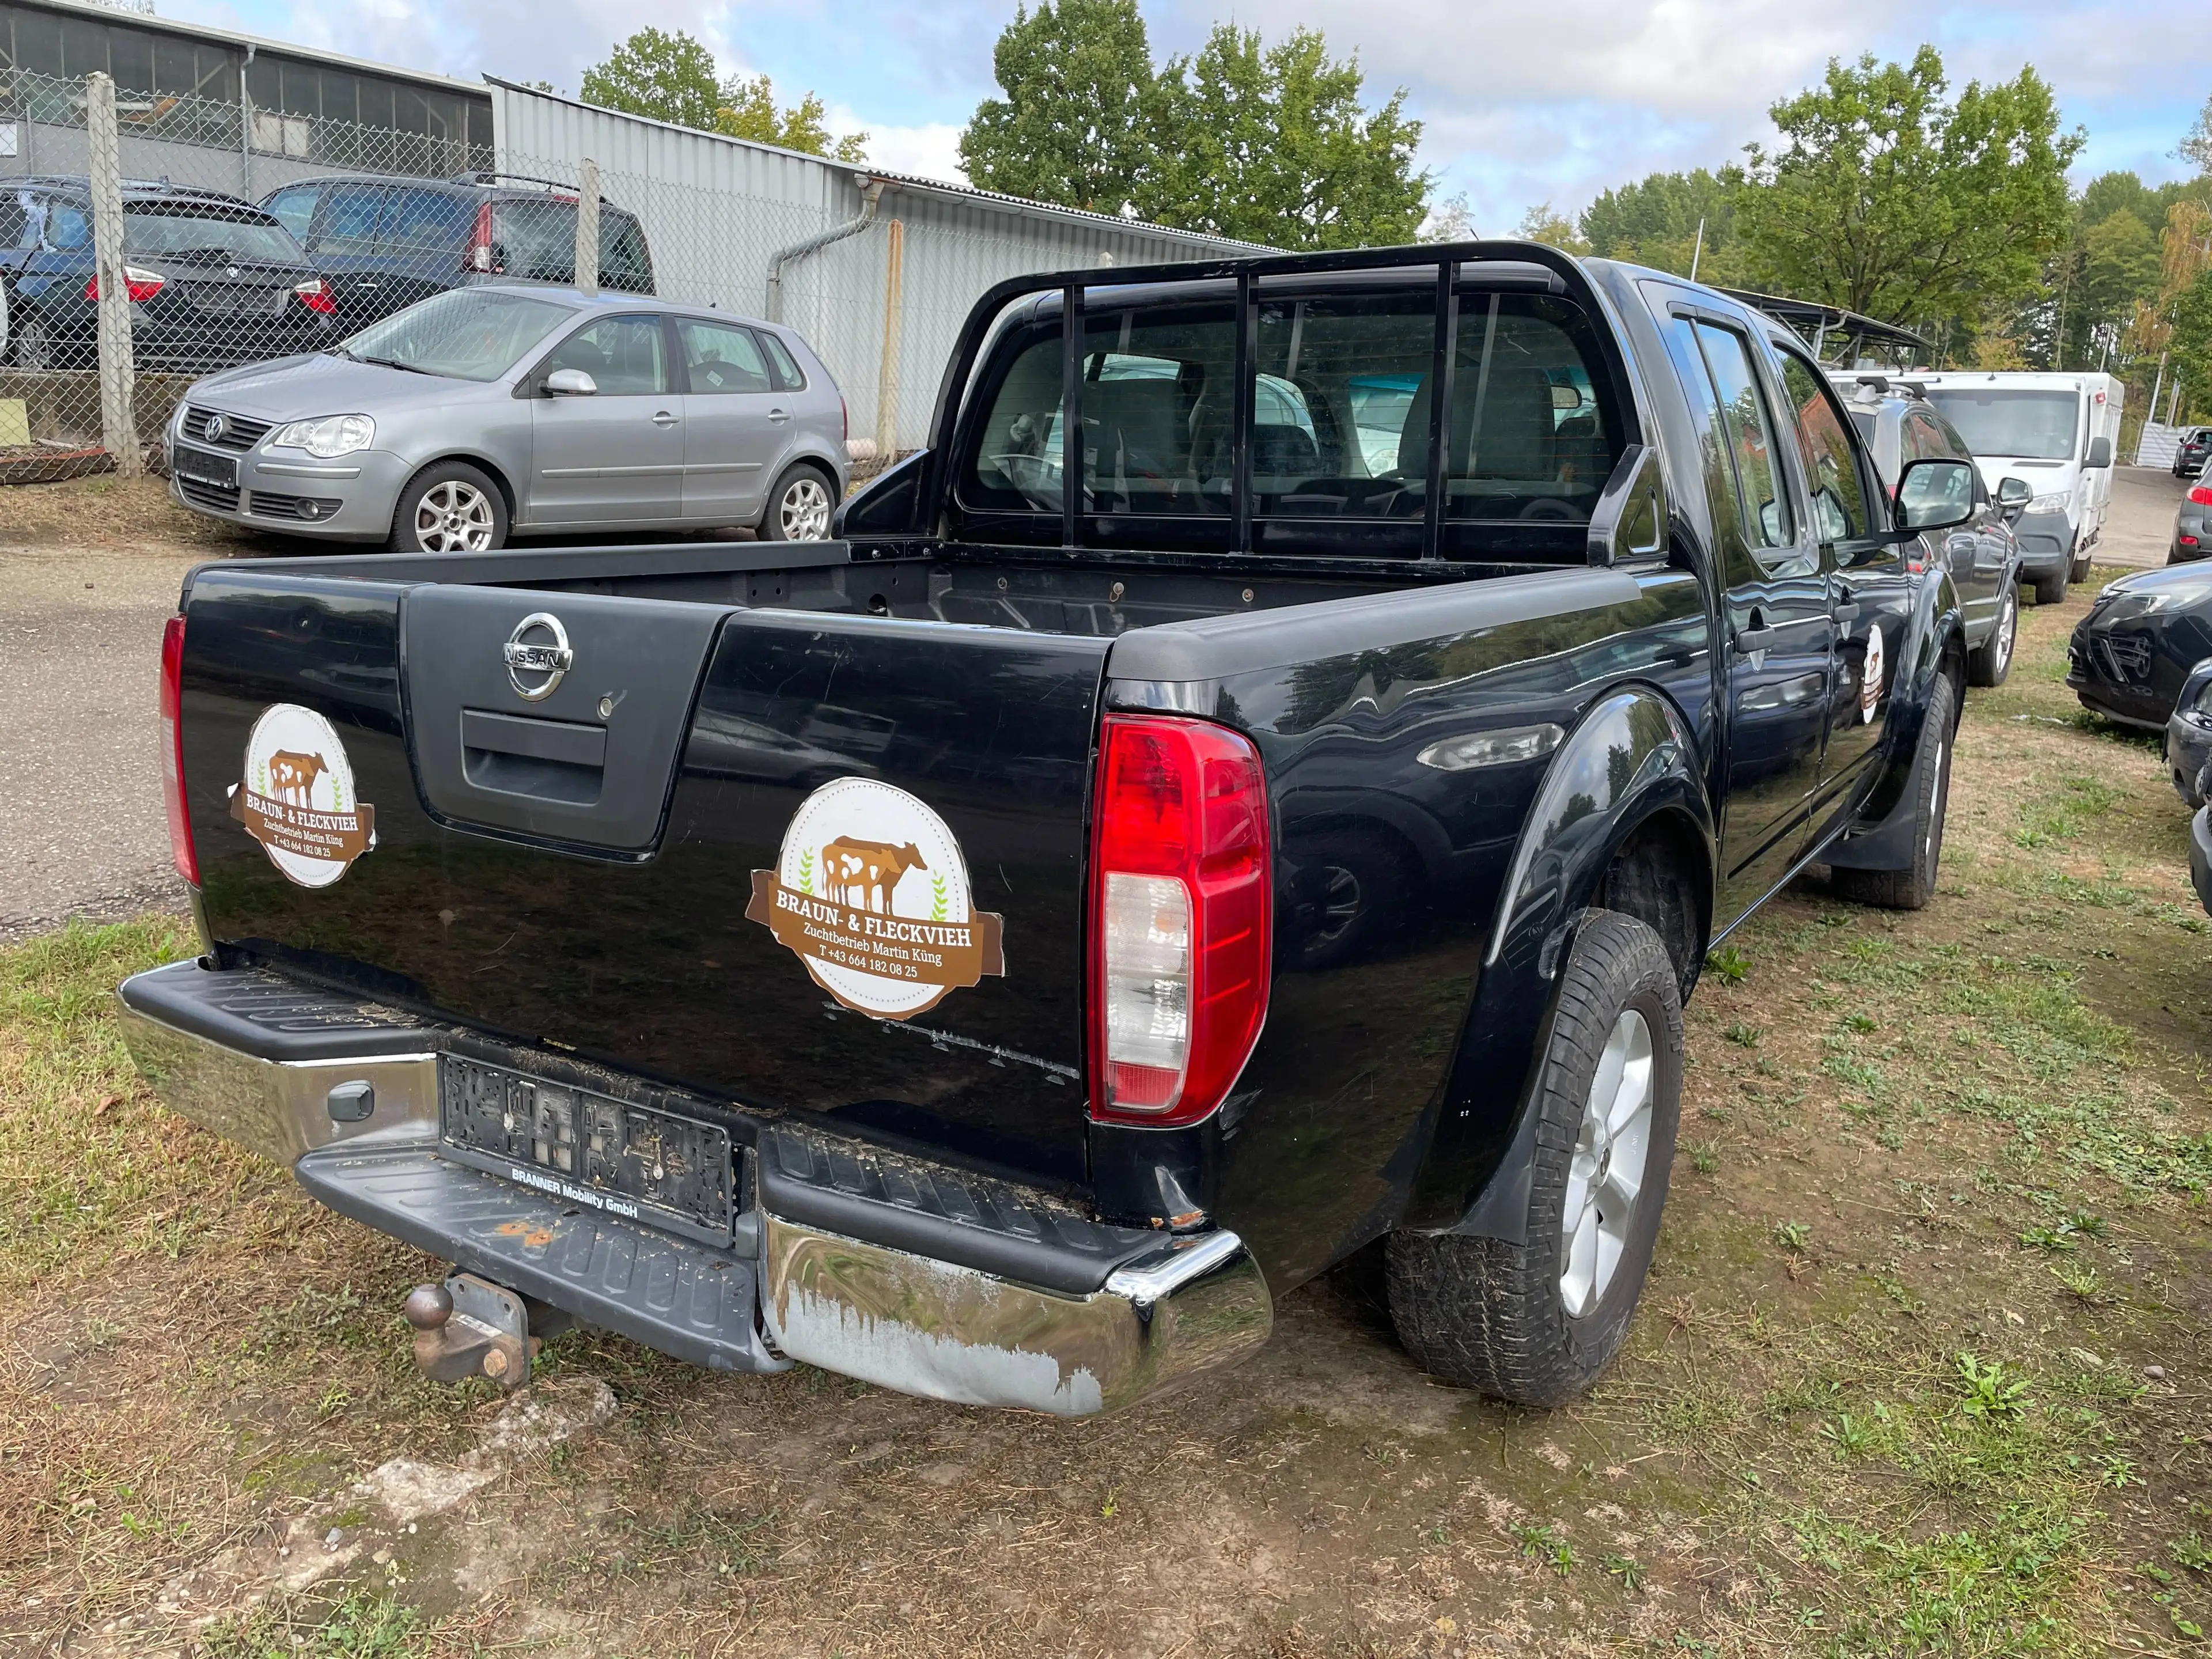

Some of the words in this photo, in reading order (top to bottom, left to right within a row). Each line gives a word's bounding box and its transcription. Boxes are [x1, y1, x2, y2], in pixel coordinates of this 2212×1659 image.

[504, 646, 560, 667] NISSAN
[247, 794, 286, 820] BRAUN-
[288, 809, 296, 824] &
[297, 810, 358, 831] FLECKVIEH
[263, 817, 302, 839] Zuchtbetrieb
[303, 830, 325, 844] Martin
[325, 833, 344, 848] Küng
[274, 835, 279, 844] T
[279, 839, 290, 849] +43
[291, 841, 302, 852] 664
[302, 844, 314, 855] 182
[315, 847, 322, 857] 08
[323, 847, 331, 857] 25
[776, 889, 844, 926] BRAUN-
[848, 913, 860, 932] &
[865, 916, 972, 947] FLECKVIEH
[804, 922, 870, 952] Zuchtbetrieb
[872, 941, 910, 960] Martin
[911, 948, 942, 967] Küng
[819, 944, 827, 956] T
[828, 949, 846, 963] +43
[849, 953, 866, 968] 664
[869, 958, 887, 972] 182
[889, 963, 902, 975] 08
[904, 965, 918, 978] 25
[512, 1168, 560, 1194] BRANNER
[562, 1184, 604, 1209] Mobility
[605, 1198, 638, 1218] GmbH
